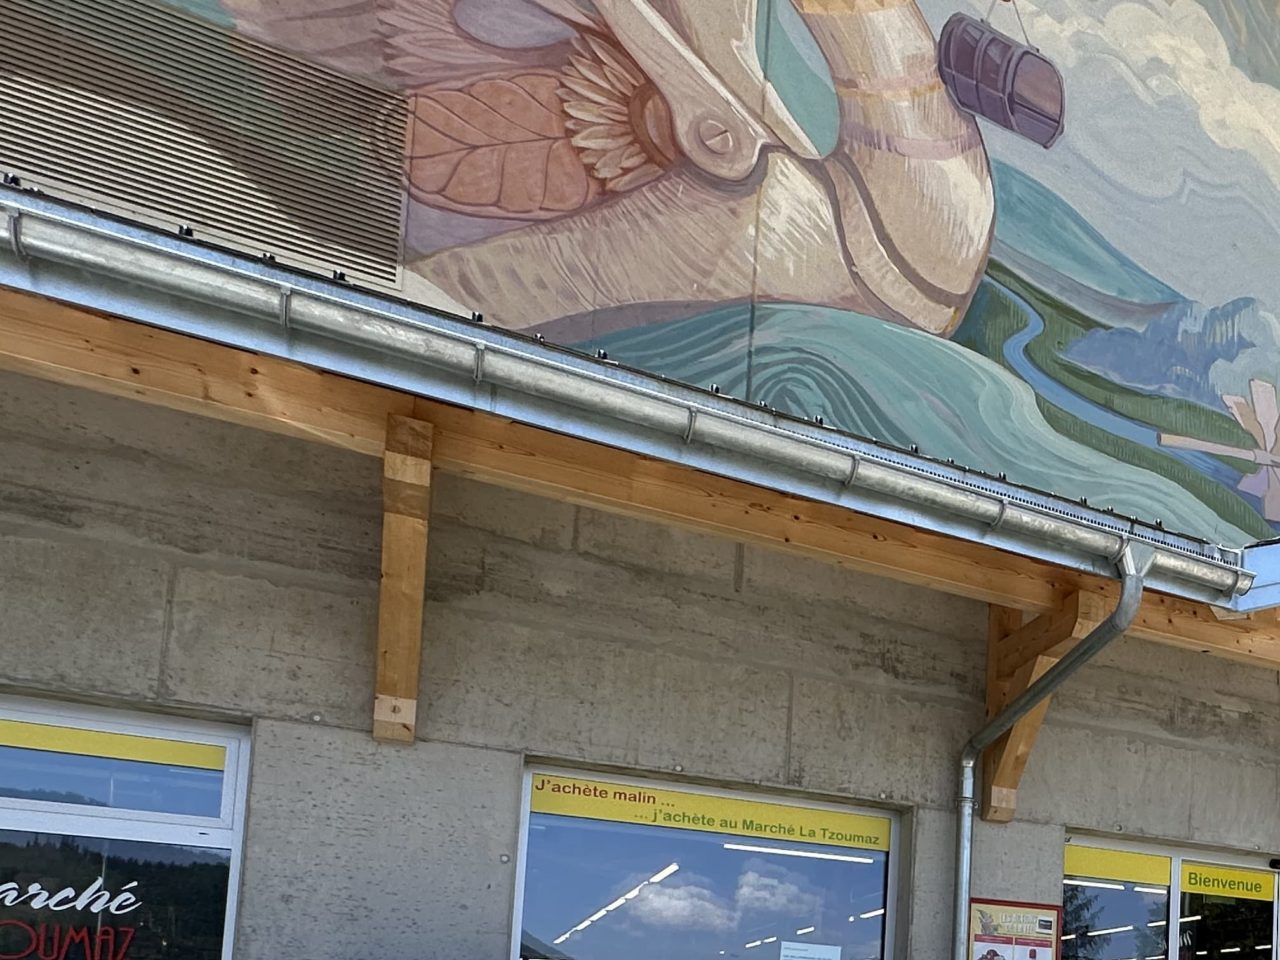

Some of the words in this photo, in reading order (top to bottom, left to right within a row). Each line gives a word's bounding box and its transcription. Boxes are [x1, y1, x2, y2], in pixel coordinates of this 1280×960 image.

[613, 790, 656, 805] malin
[720, 818, 738, 829] au
[742, 818, 796, 836] Marché
[799, 825, 816, 838] La
[820, 827, 880, 846] Tzoumaz
[1188, 871, 1262, 893] Bienvenue
